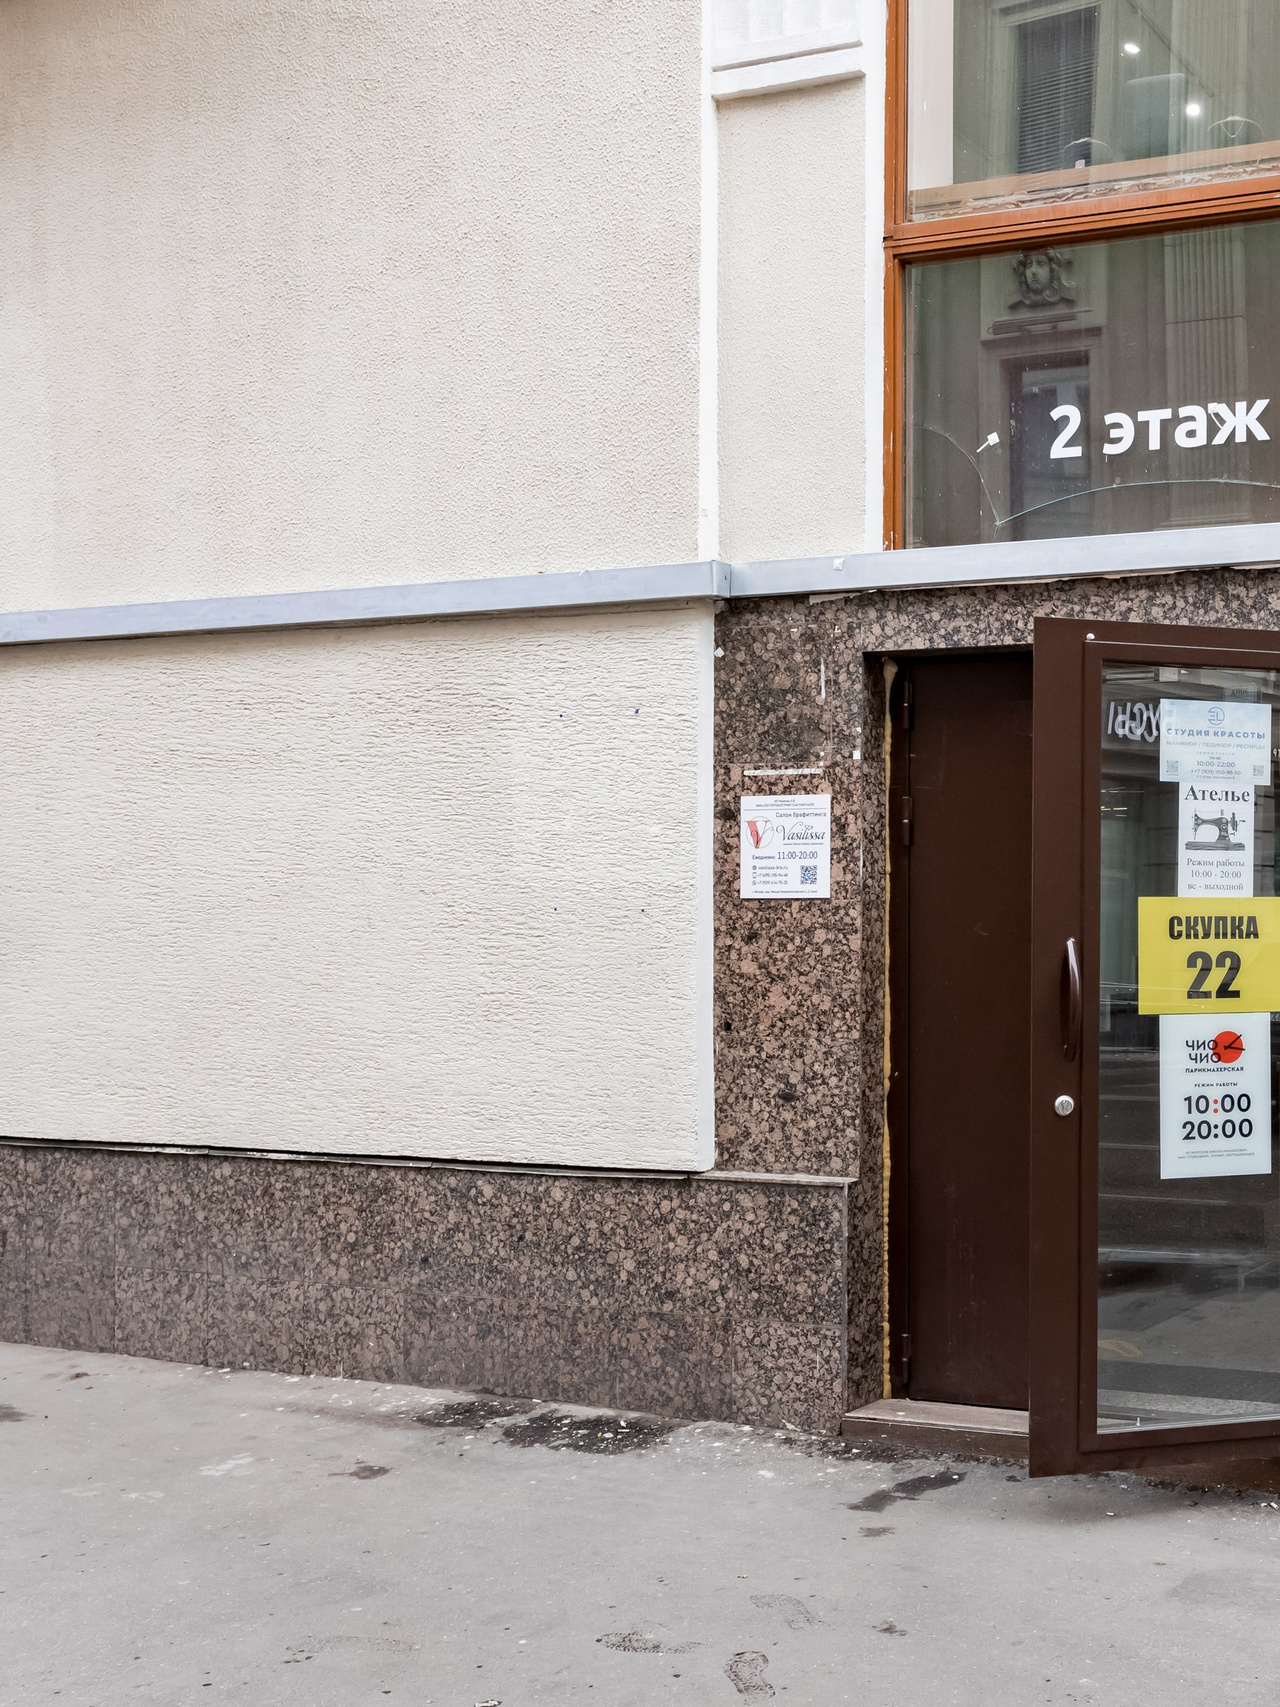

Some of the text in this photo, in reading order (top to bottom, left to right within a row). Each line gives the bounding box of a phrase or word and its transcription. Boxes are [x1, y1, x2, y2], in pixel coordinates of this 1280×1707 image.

[1049, 398, 1271, 460] 2 этаж
[1166, 728, 1266, 740] СТУДИЯ КРАСОТЫ
[1184, 785, 1250, 802] Ателье
[776, 821, 826, 841] Vasilissa
[778, 850, 818, 860] 11:00-20:00
[1186, 858, 1245, 869] Режим работы
[1190, 870, 1212, 878] 10:00
[1220, 870, 1242, 879] 20:00
[1204, 882, 1244, 892] выходной
[1168, 915, 1260, 941] СКУПКА
[1186, 950, 1242, 1000] 22
[1186, 1040, 1218, 1051] ЧИО
[1188, 1052, 1222, 1064] ЧИО
[1184, 1094, 1252, 1115] 10:00
[1182, 1118, 1253, 1141] 20:00
